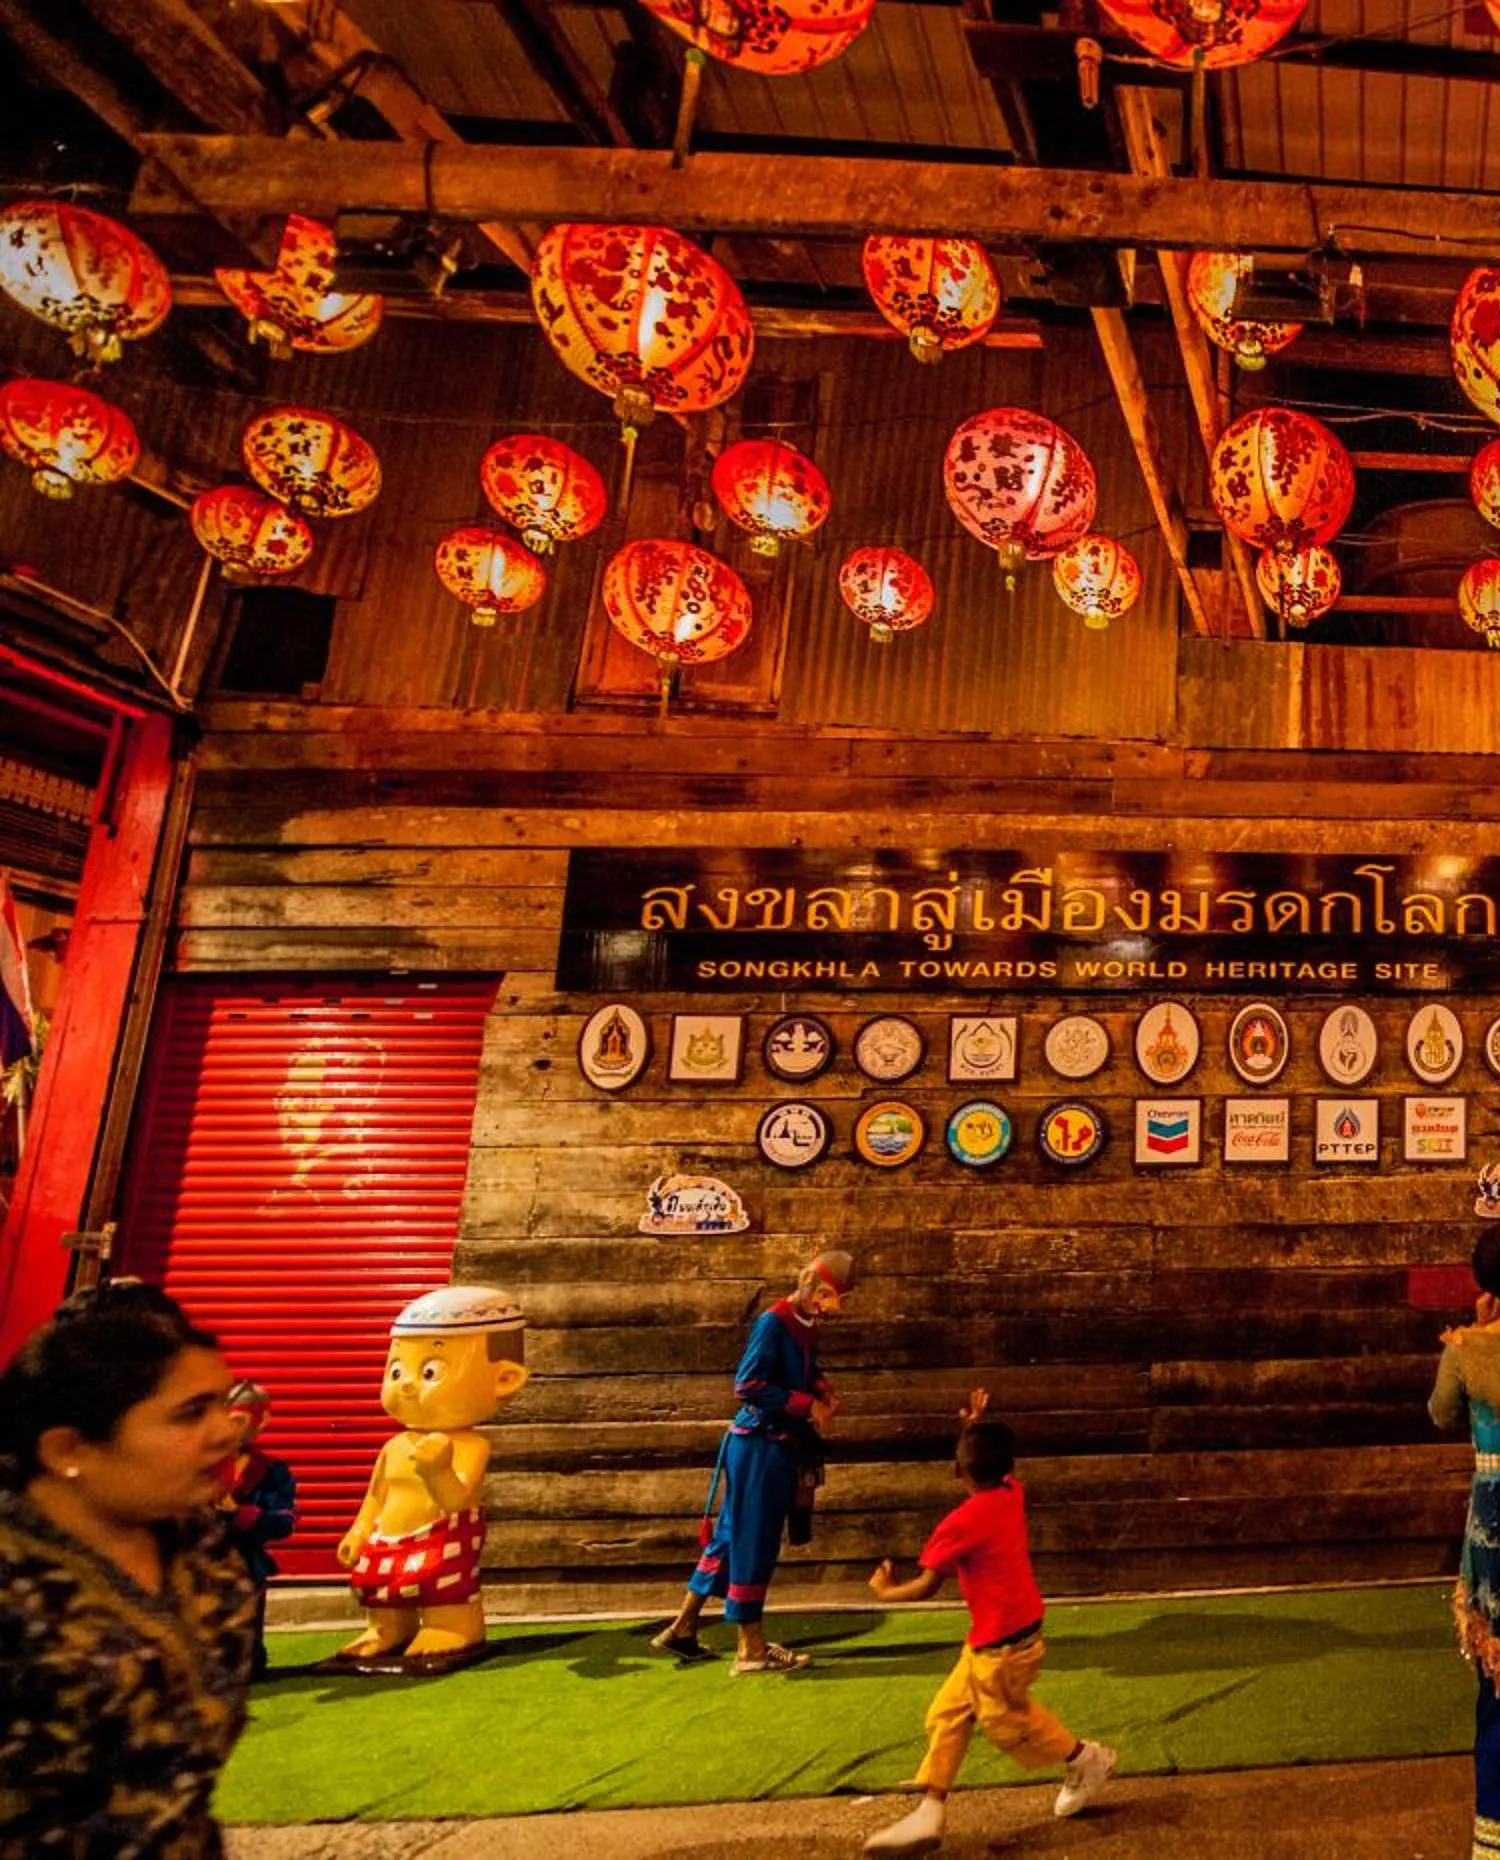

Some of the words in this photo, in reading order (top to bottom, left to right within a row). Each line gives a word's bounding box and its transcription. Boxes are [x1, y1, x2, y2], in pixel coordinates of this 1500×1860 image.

[641, 864, 1497, 951] สงขลาสู่เมืองมรดกโลก
[697, 961, 880, 978] SONGKHLA
[898, 961, 1057, 978] TOWARDS
[1075, 961, 1188, 979] WORLD
[1206, 961, 1358, 979] HERITAGE
[1375, 962, 1440, 979] SITE
[1318, 1143, 1376, 1155] PTTEP
